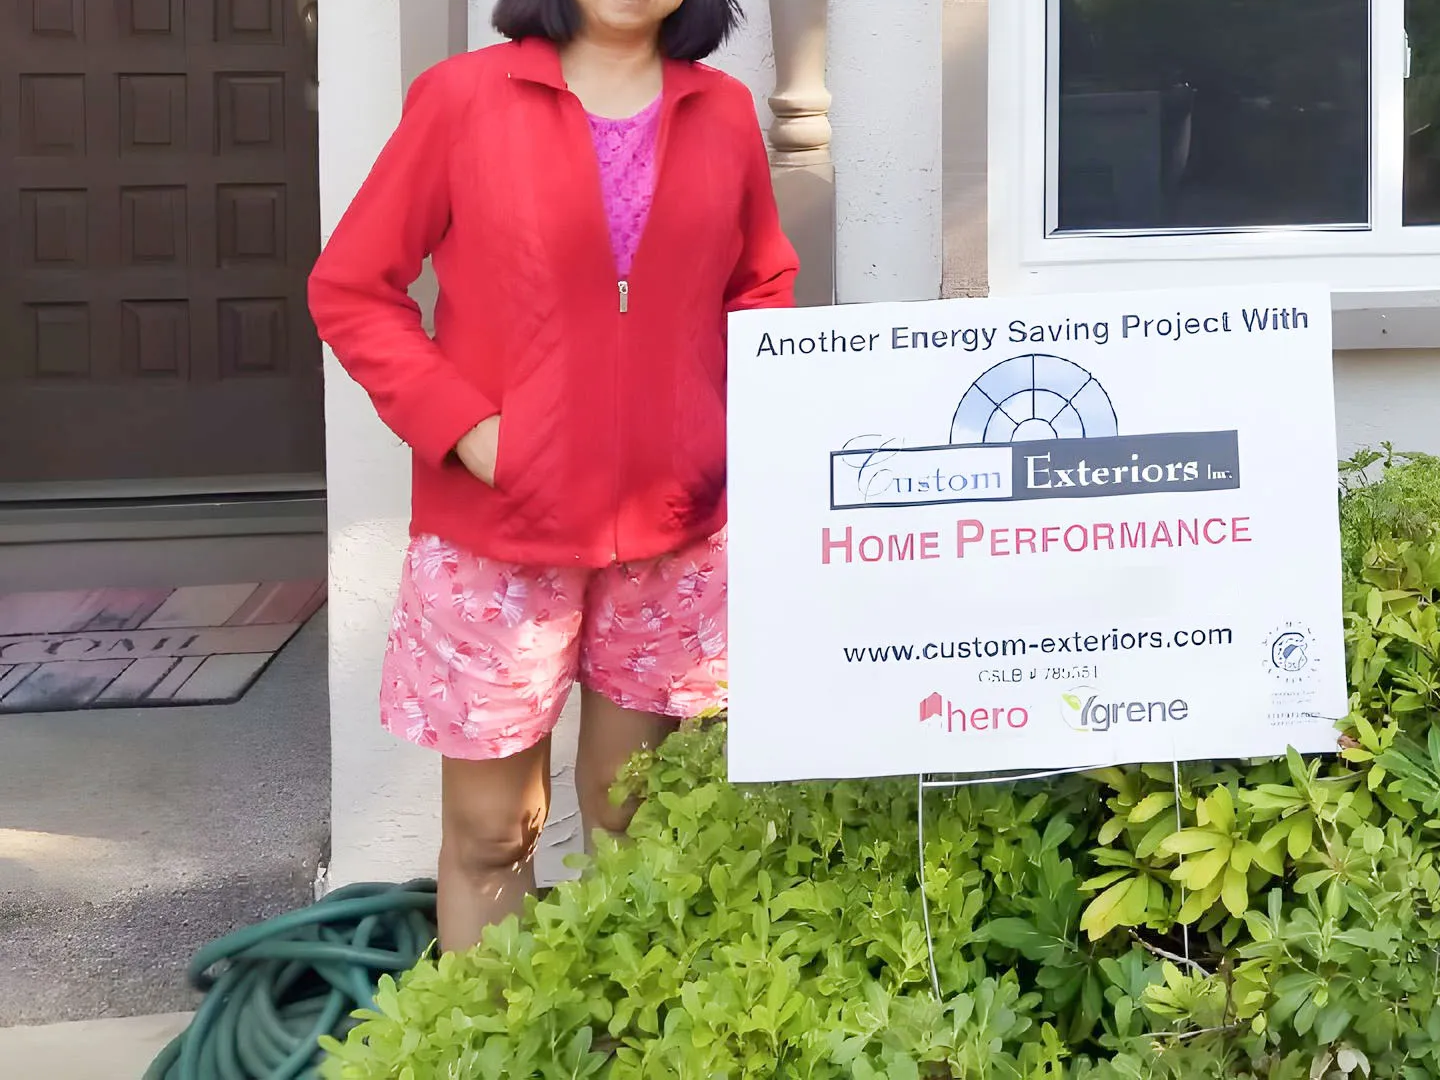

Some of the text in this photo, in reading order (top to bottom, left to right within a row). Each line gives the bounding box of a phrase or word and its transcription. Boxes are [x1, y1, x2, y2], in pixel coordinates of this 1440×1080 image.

[756, 306, 1309, 358] Another Energy Saving Project With
[841, 433, 1002, 502] Custom
[1024, 450, 1200, 491] Exteriors
[843, 624, 1234, 665] www.custom-exteriors.com
[946, 698, 1028, 733] hero
